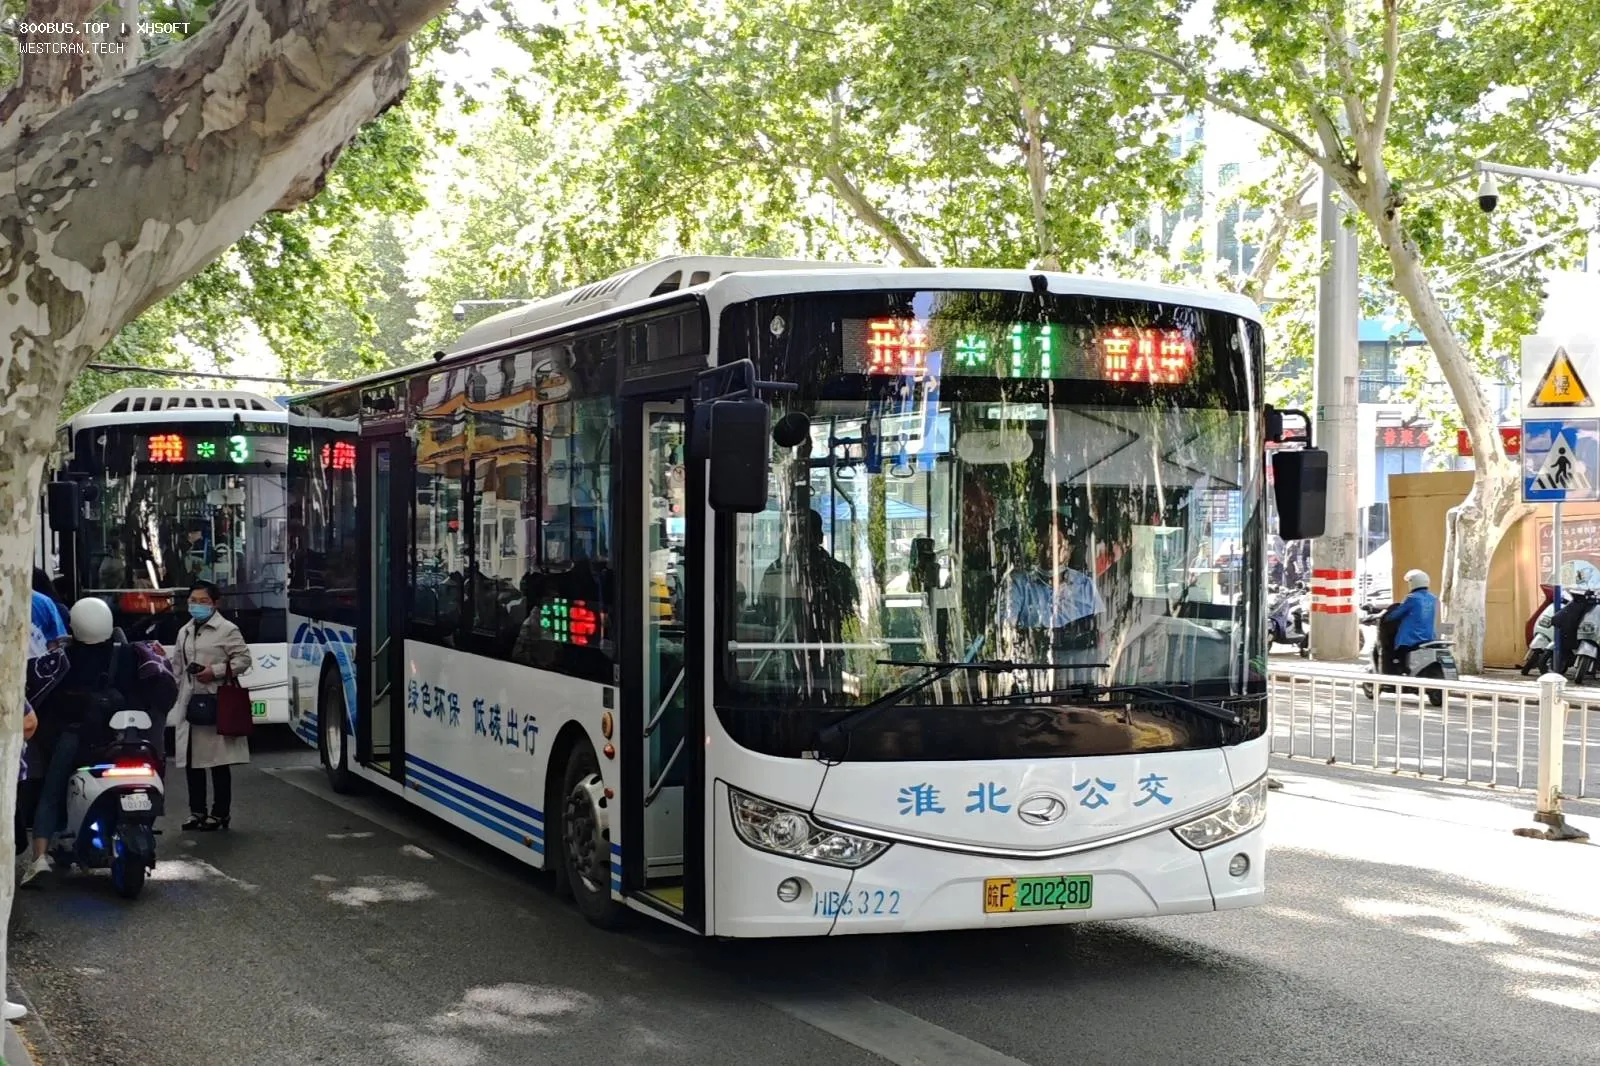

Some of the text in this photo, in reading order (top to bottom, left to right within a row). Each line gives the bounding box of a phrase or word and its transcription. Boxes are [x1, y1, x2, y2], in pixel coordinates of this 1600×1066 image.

[229, 434, 249, 464] 3
[407, 679, 539, 756] 绿色环保 低碳出行
[895, 771, 1174, 817] 淮北公交
[812, 889, 901, 916] HB6322
[986, 879, 1091, 908] 皖F 20228D
